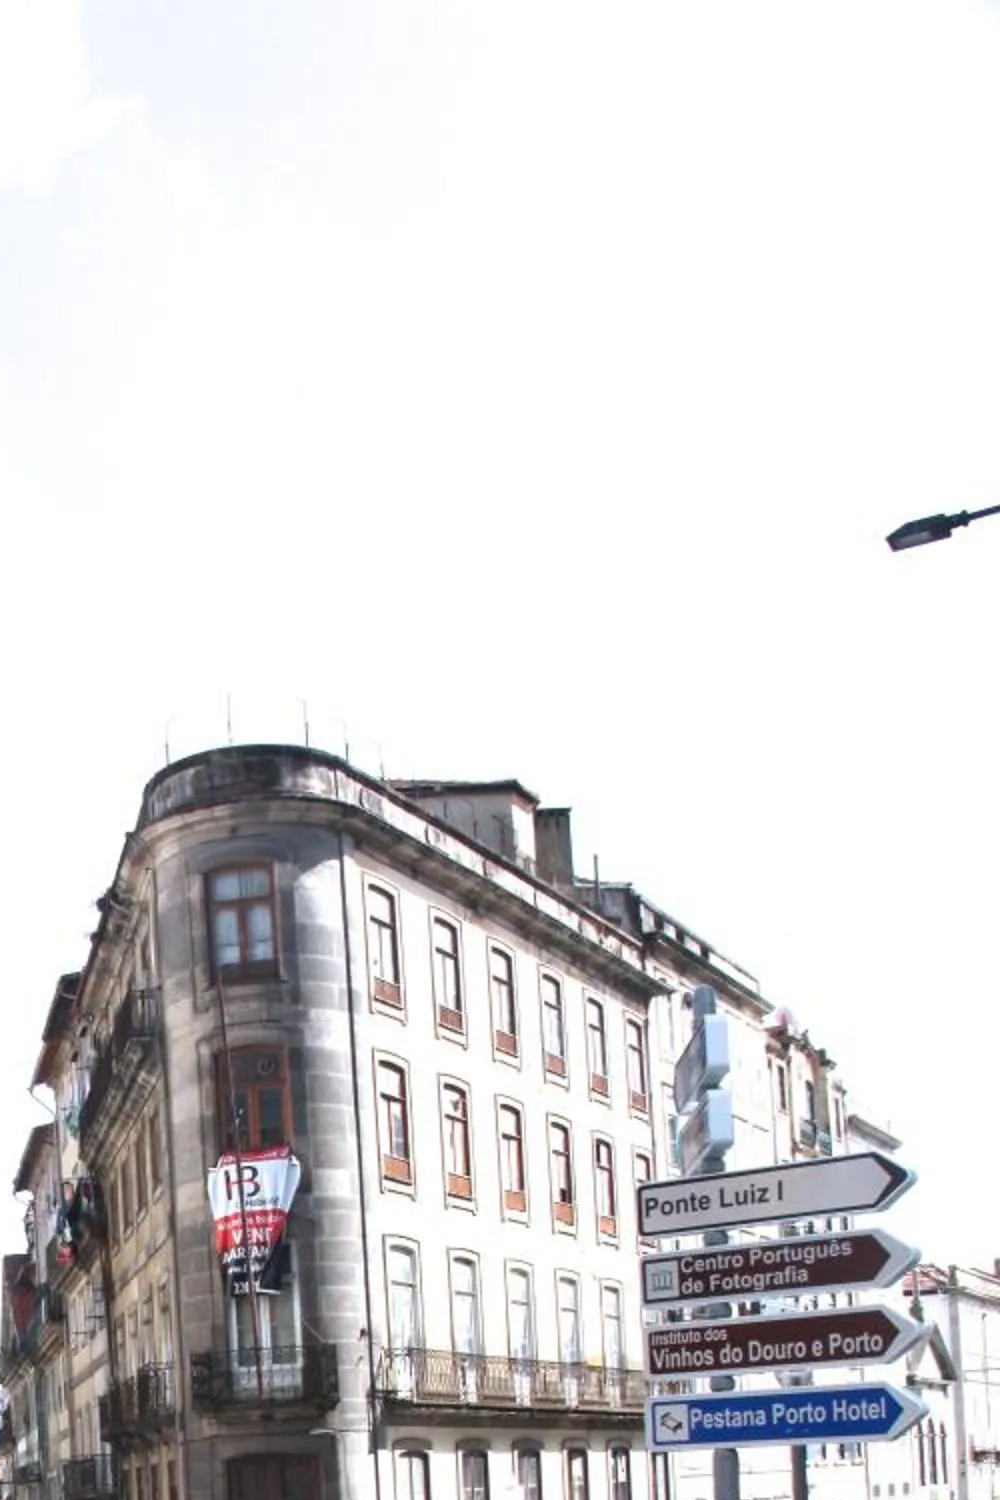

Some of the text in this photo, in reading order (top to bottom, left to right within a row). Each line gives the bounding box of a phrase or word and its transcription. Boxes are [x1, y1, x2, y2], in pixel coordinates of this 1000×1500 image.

[645, 1180, 783, 1218] Ponte Luiz I
[680, 1240, 853, 1273] Centro Português
[681, 1266, 808, 1294] de Fotografia
[651, 1327, 728, 1346] Instituto dos
[652, 1332, 883, 1369] Vinhos do Douro e Porto
[690, 1397, 886, 1430] Pestana Porto Hotel
